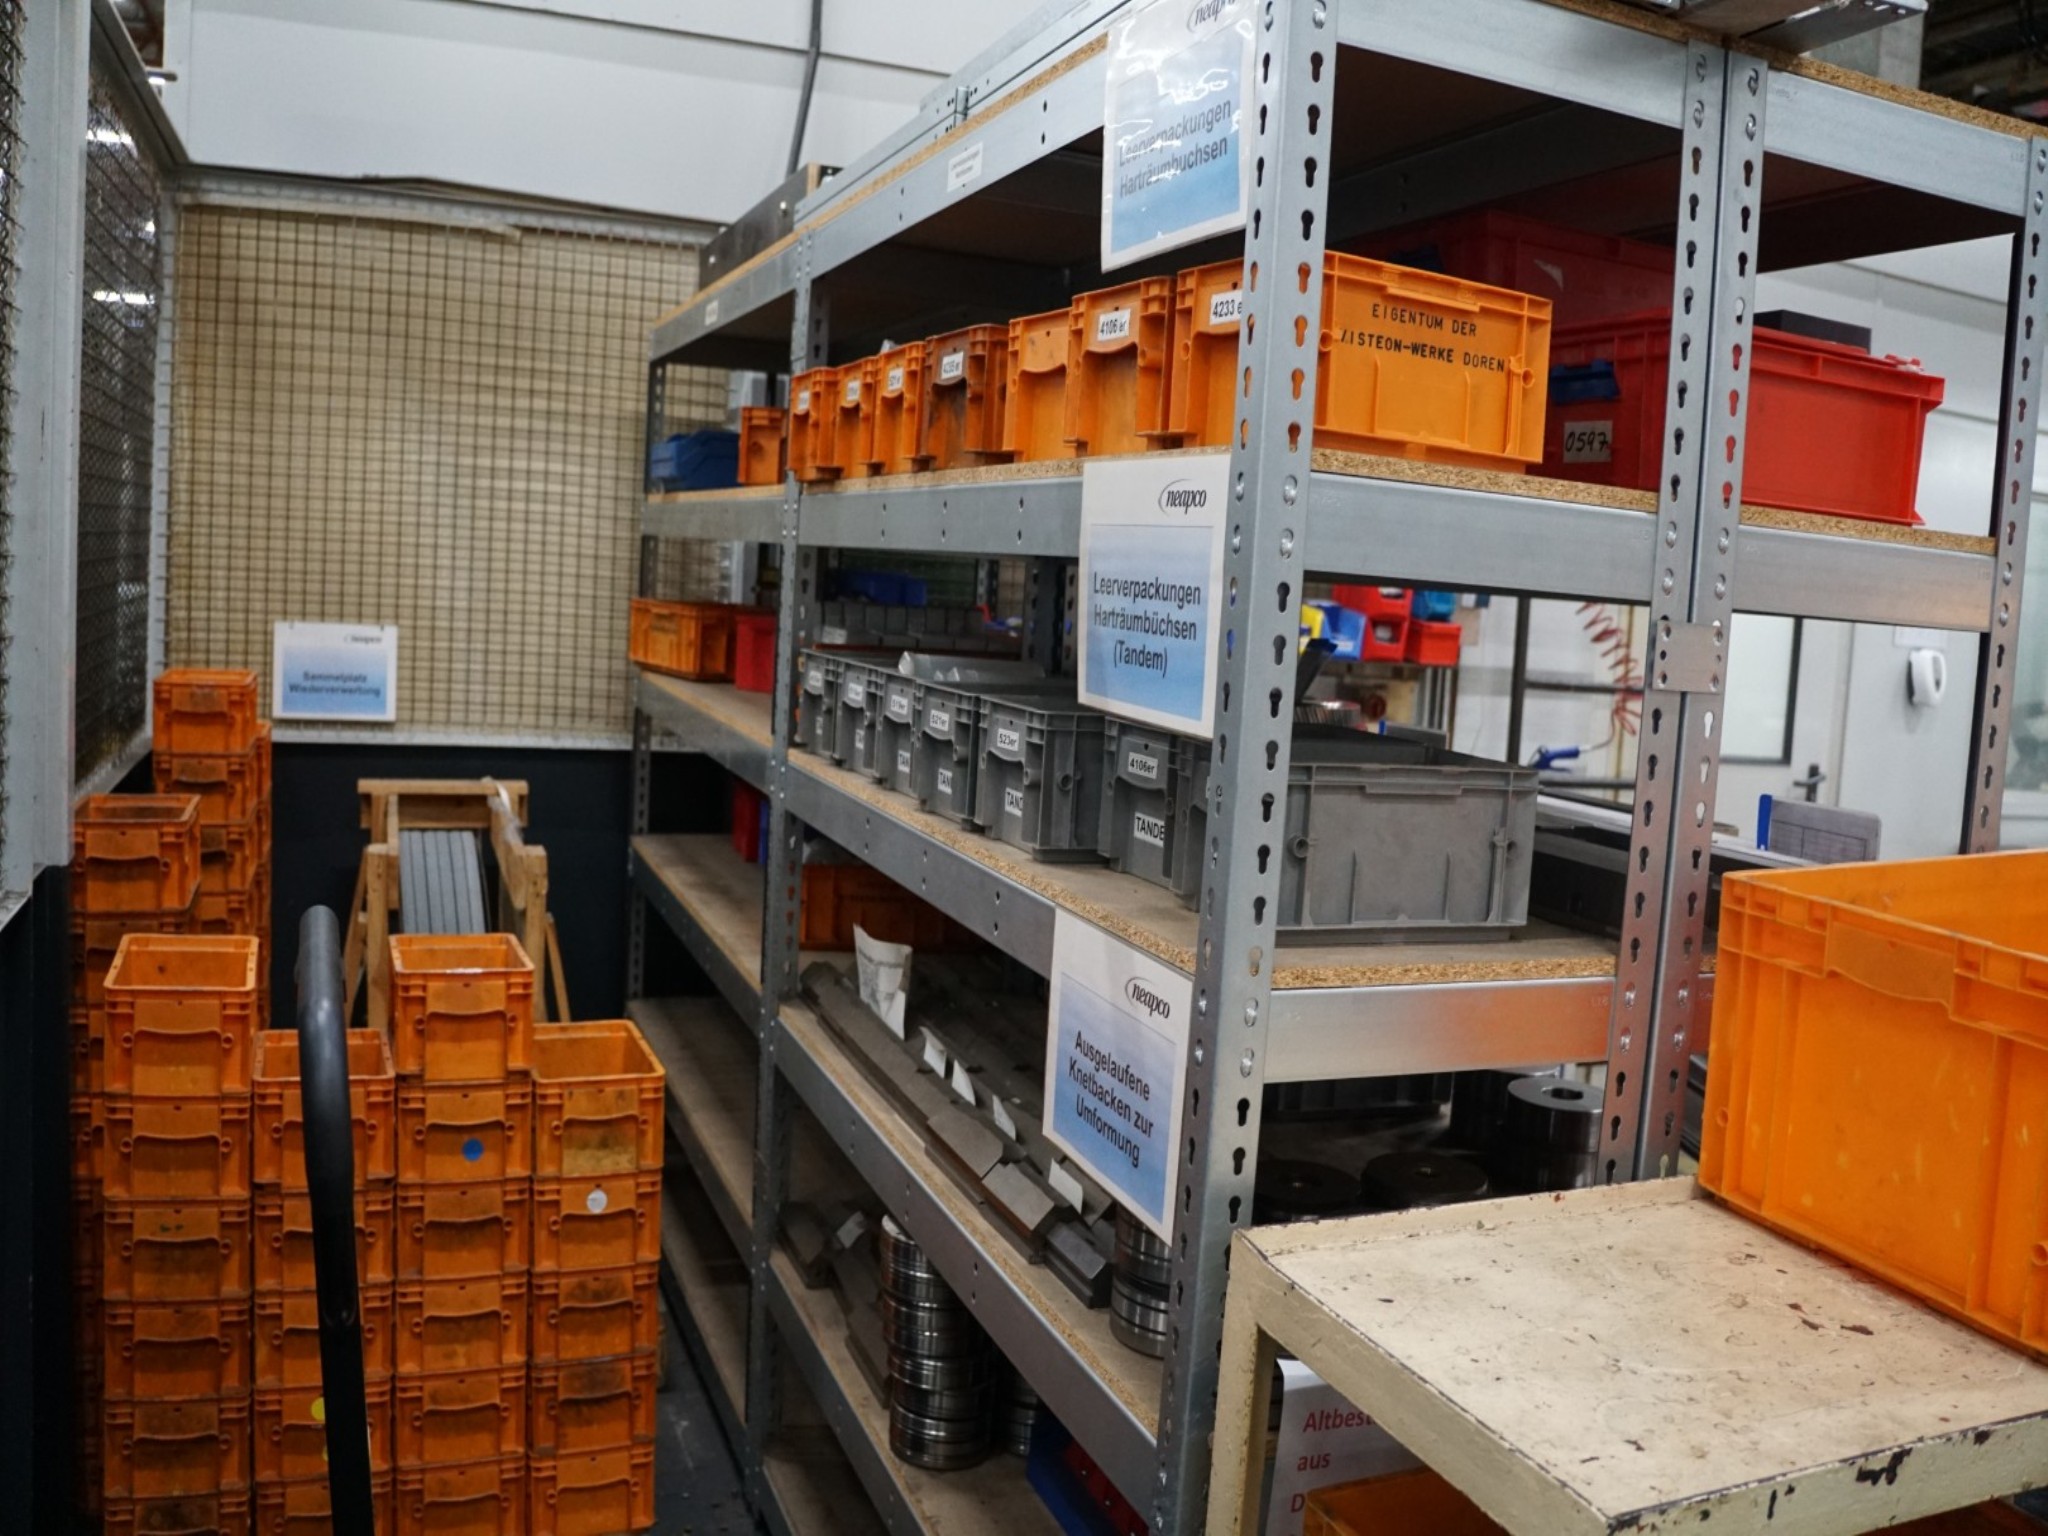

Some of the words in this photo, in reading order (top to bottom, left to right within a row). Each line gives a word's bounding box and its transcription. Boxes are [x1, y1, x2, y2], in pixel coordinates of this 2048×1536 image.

[1118, 100, 1232, 168] Leerverpackungen
[1213, 299, 1235, 318] 4233
[1372, 303, 1443, 331] EIGENTUM
[1451, 320, 1477, 337] DER
[1100, 318, 1118, 336] 4106
[1166, 489, 1207, 515] neapco
[1093, 571, 1202, 609] Leerverpackungen
[1093, 604, 1197, 641] Harträumbüchsen
[1113, 639, 1168, 679] (Tandem)
[1129, 758, 1156, 775] 4106er
[1131, 983, 1170, 1019] neapco
[1075, 1030, 1151, 1102] Ausgelaufene
[1068, 1056, 1131, 1123] Knetbacken
[1133, 1108, 1154, 1139] zur
[1075, 1094, 1141, 1168] Umformung
[1303, 1408, 1377, 1433] Altbest
[1297, 1453, 1331, 1471] aus
